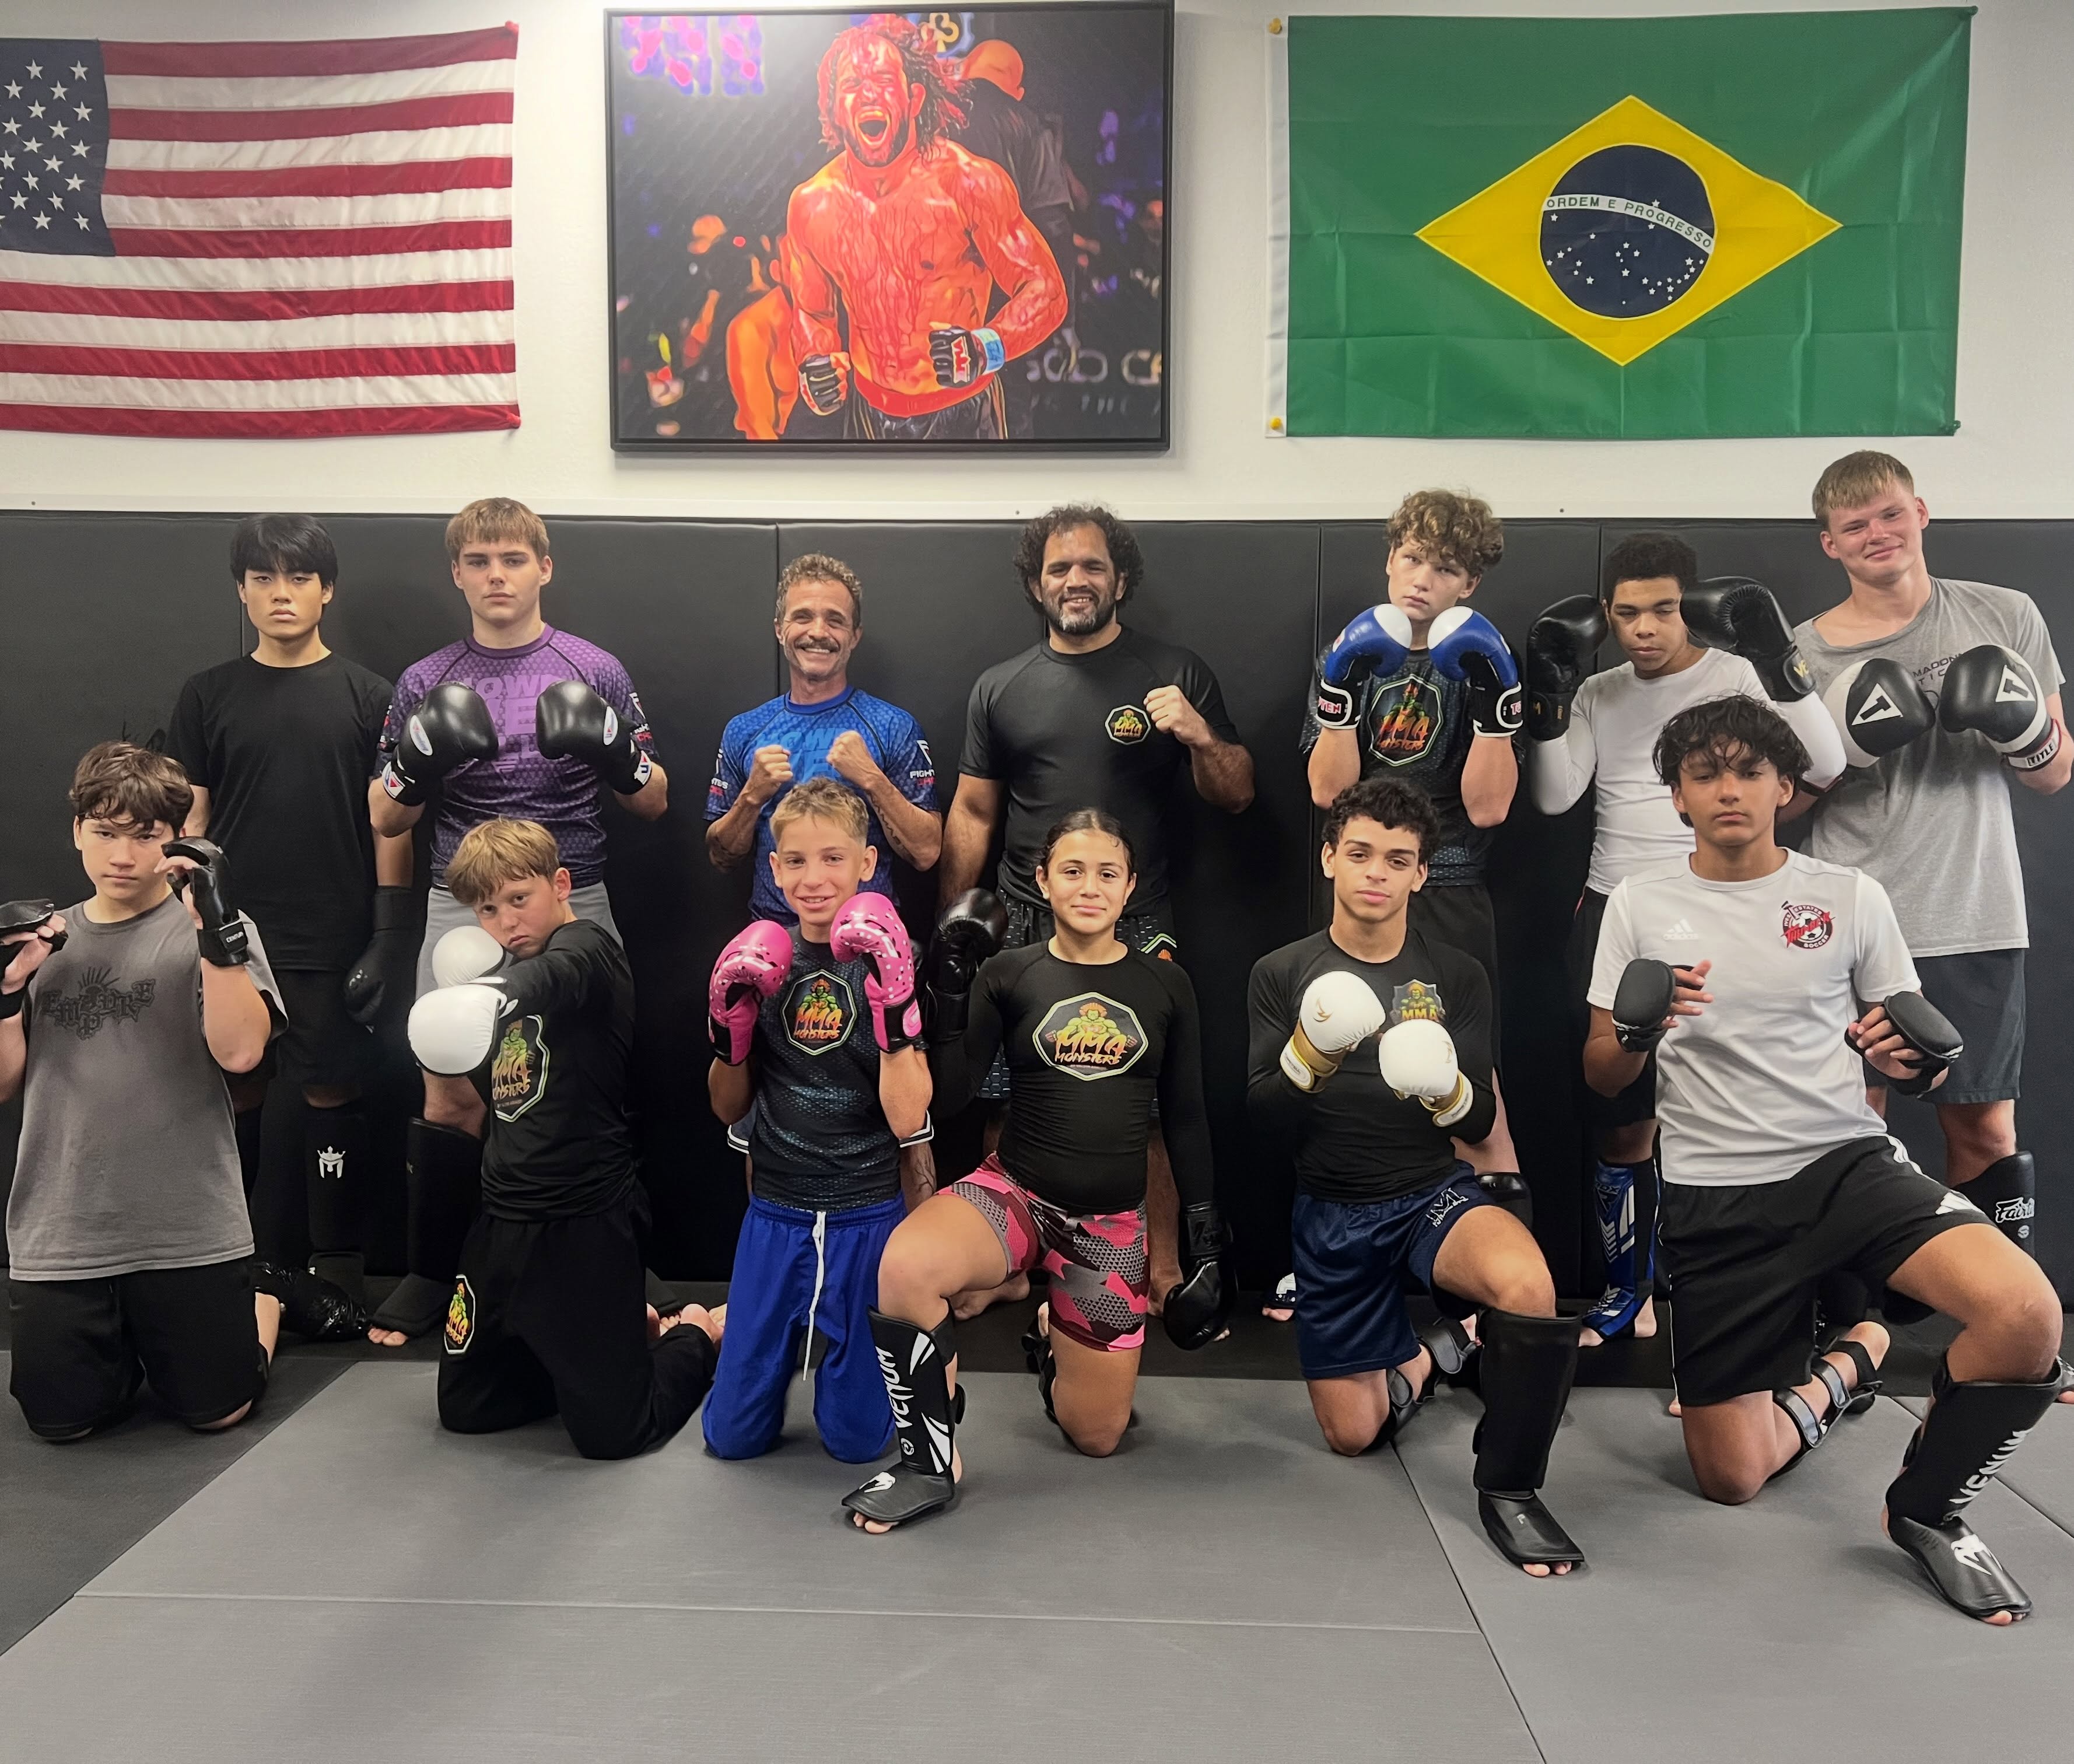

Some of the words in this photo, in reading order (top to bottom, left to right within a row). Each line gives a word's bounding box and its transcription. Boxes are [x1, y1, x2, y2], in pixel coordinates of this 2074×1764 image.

[1546, 196, 1600, 208] ORDEM
[1607, 199, 1616, 209] E
[1624, 202, 1712, 248] PROGRESSO
[2028, 743, 2054, 764] TITLE
[1803, 934, 1829, 949] SOCCER
[794, 1006, 843, 1031] MMA
[1401, 1007, 1439, 1021] MMA
[1055, 1029, 1128, 1054] MMA
[1054, 1051, 1122, 1066] MONSTERS
[875, 1345, 915, 1429] VENUM
